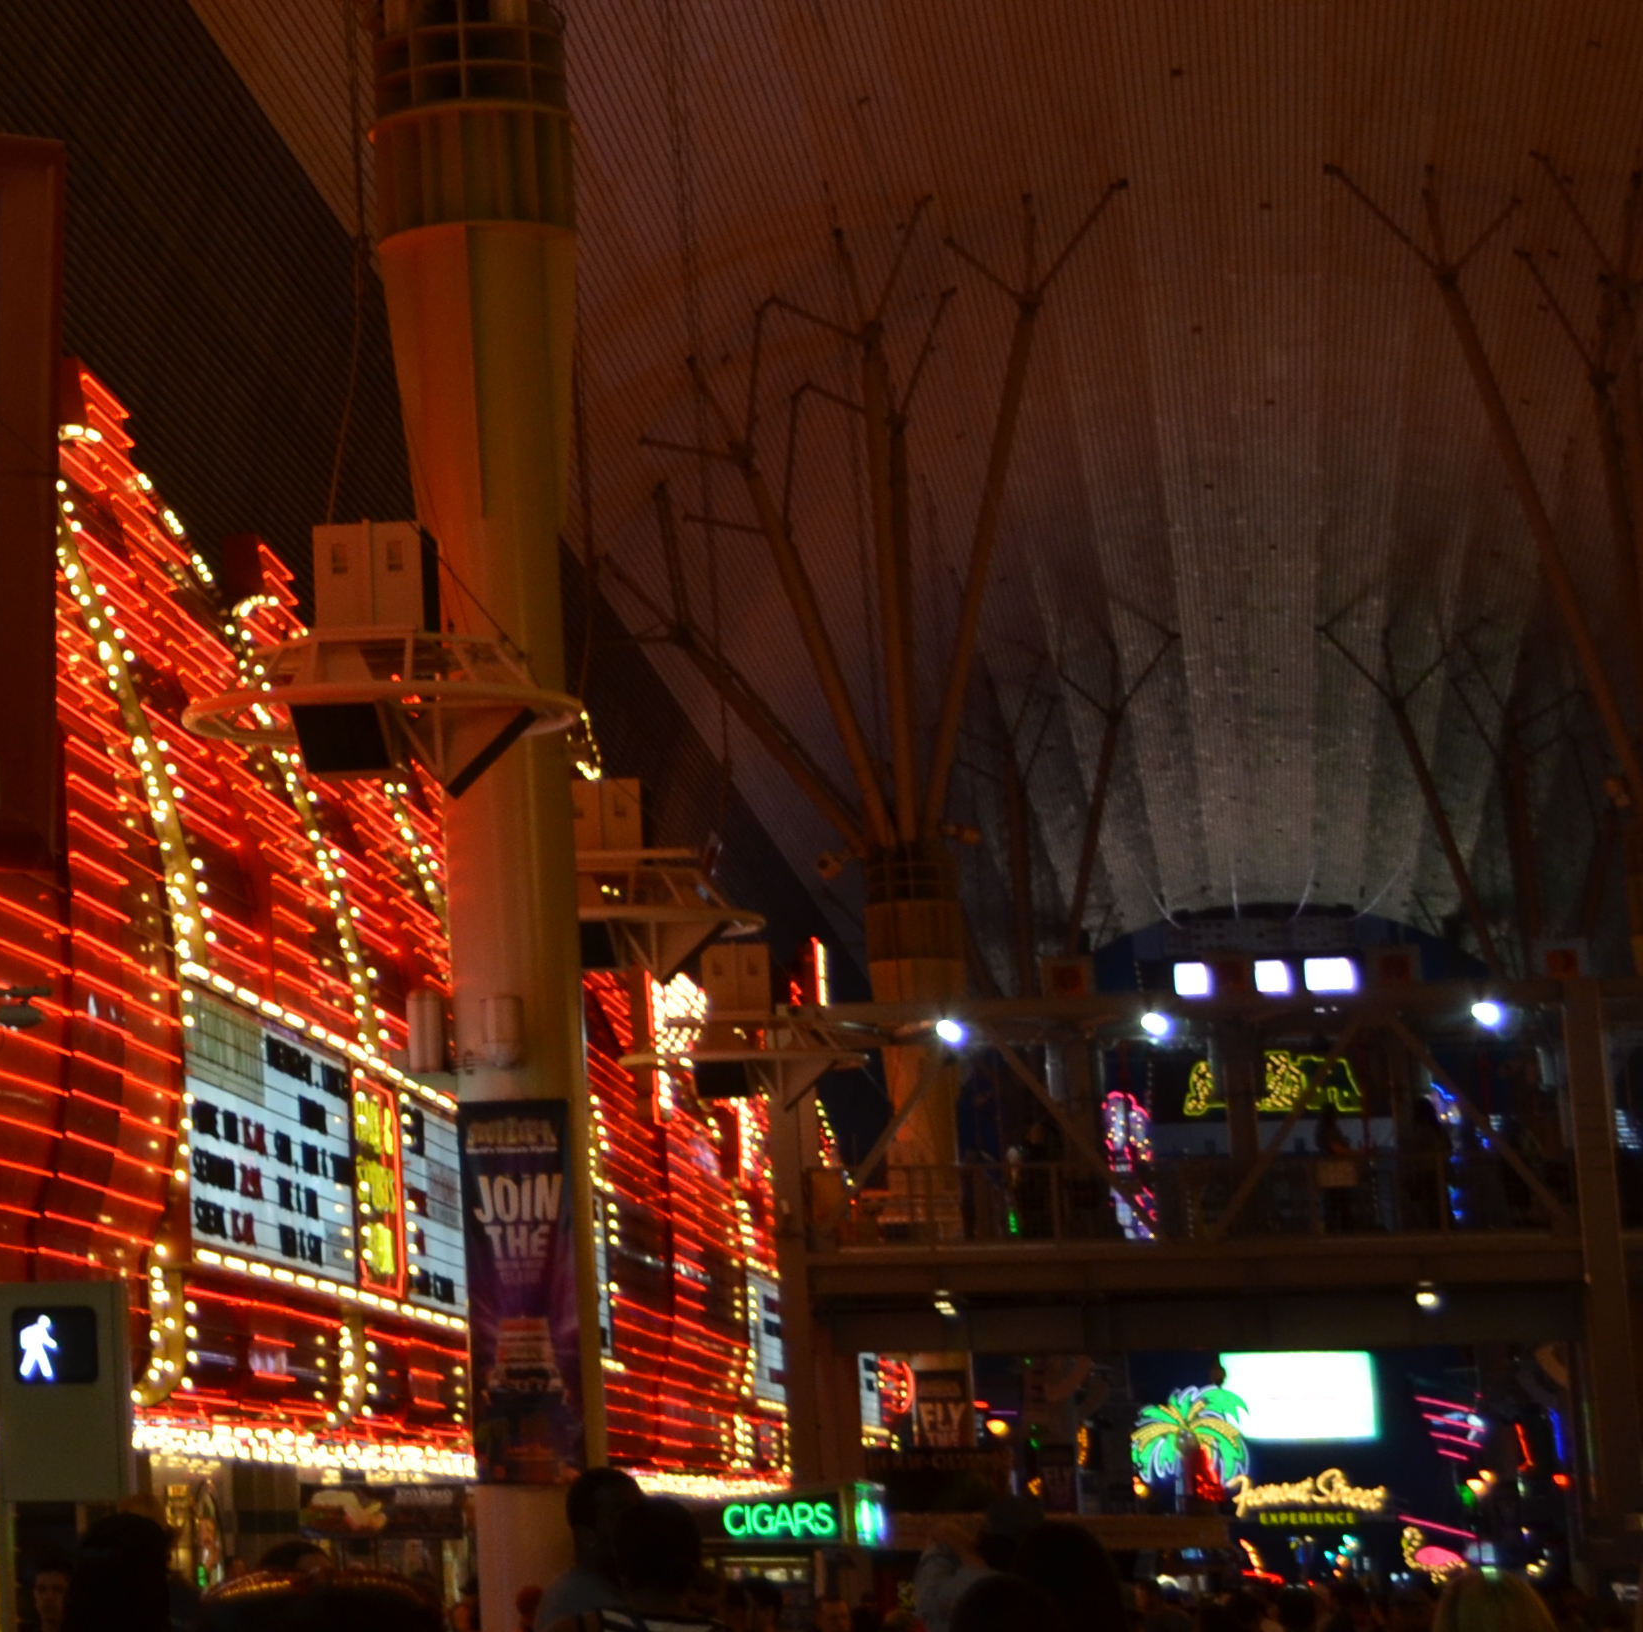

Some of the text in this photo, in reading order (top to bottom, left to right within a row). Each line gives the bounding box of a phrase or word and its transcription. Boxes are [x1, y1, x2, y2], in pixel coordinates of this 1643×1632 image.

[484, 1223, 551, 1259] THE
[722, 1501, 837, 1539] CIGARS
[1259, 1511, 1355, 1526] EXPERIENCE
